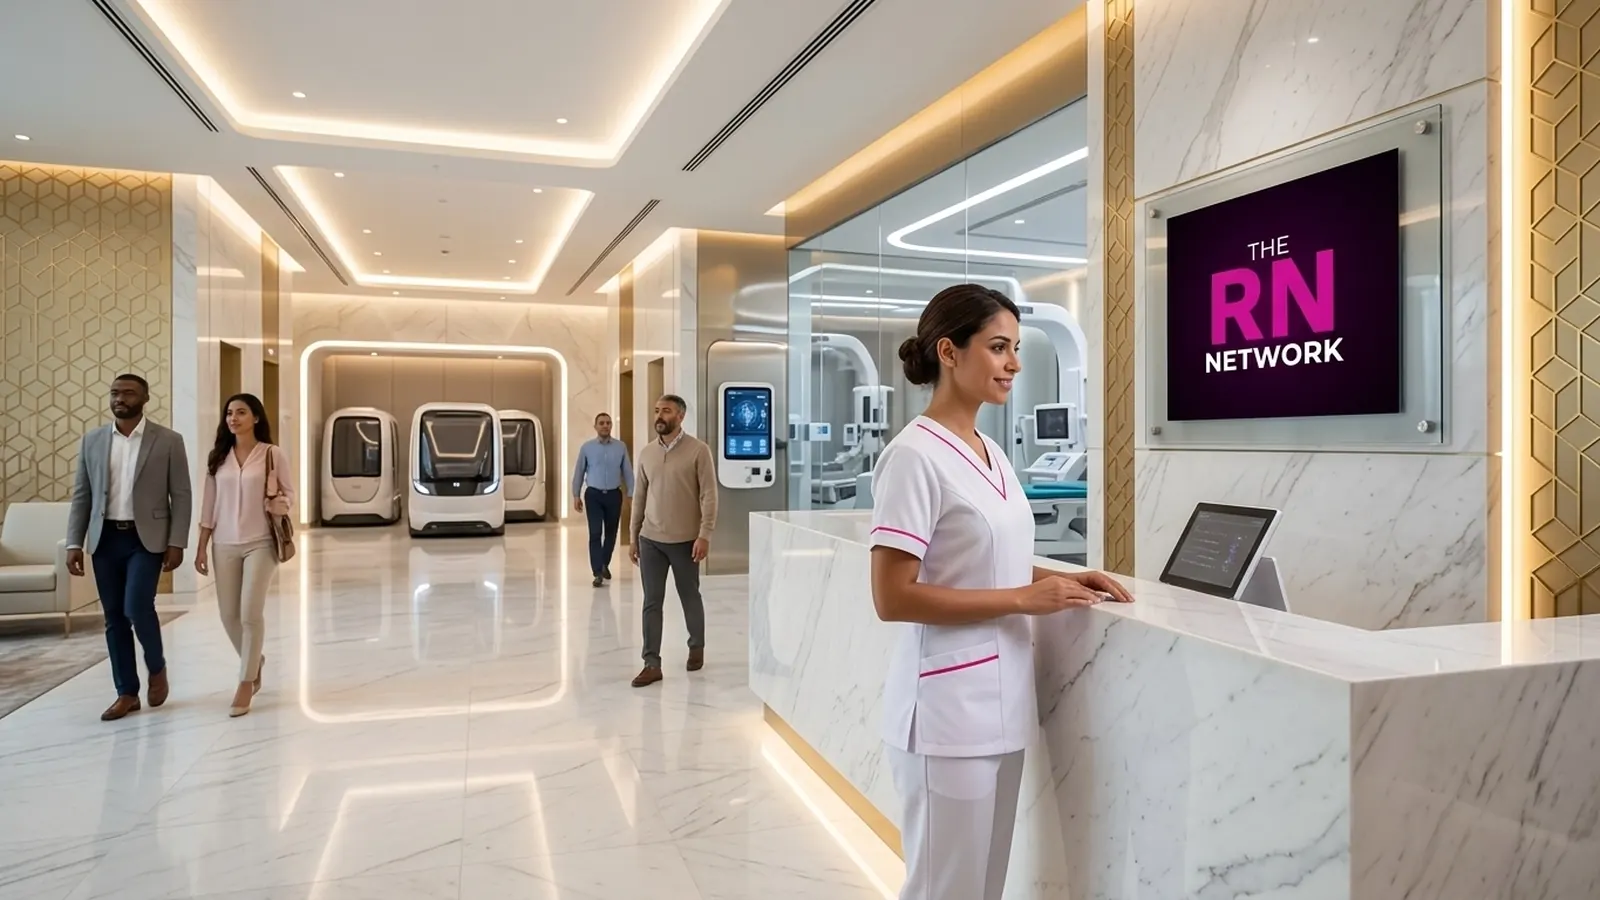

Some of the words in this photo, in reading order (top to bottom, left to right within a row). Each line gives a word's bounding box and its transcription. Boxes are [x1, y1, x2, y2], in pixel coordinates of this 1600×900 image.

[1247, 235, 1290, 261] THE
[1211, 249, 1334, 345] RN
[1205, 337, 1344, 373] NETWORK
